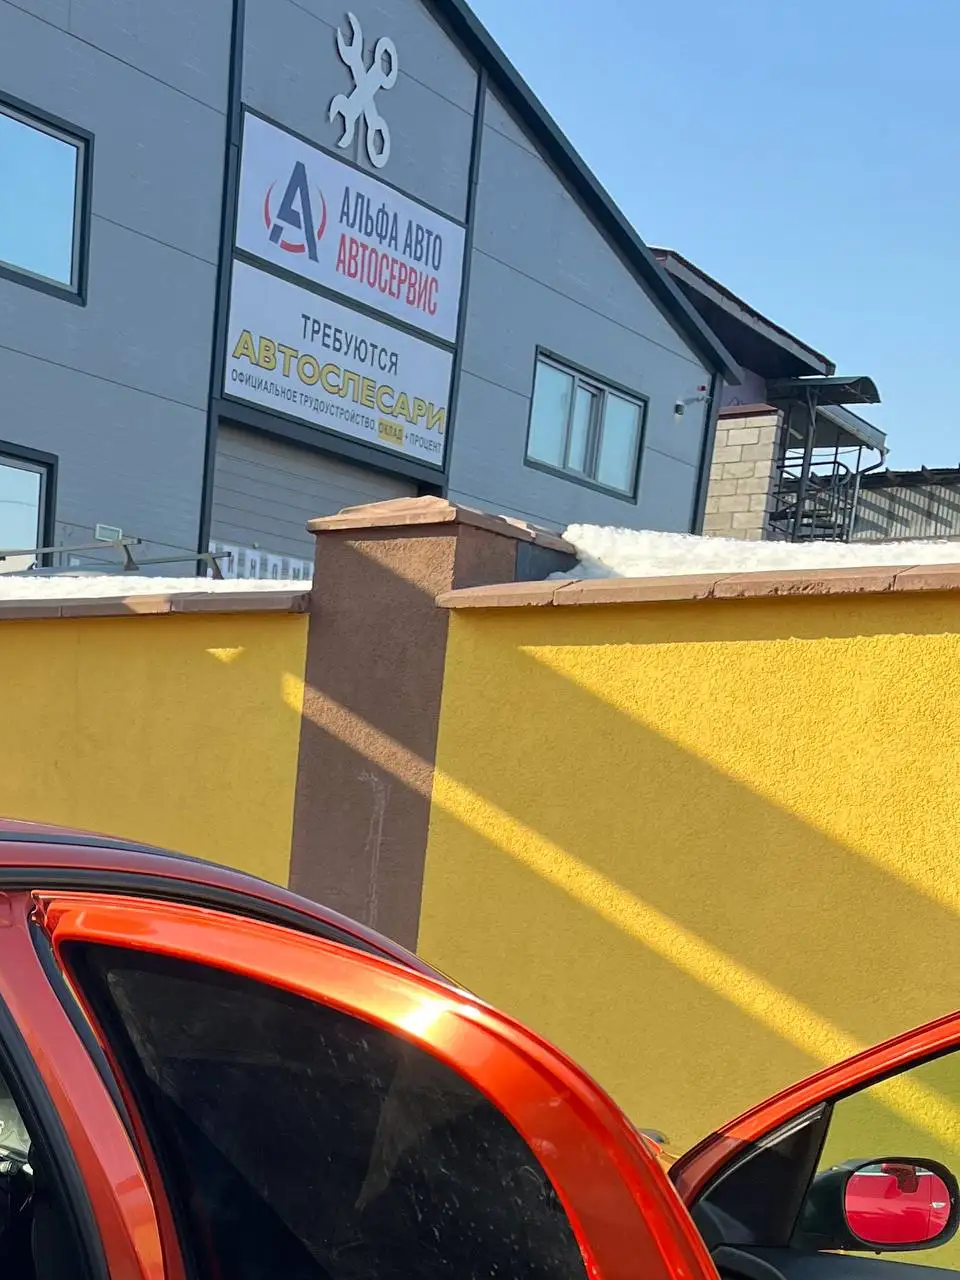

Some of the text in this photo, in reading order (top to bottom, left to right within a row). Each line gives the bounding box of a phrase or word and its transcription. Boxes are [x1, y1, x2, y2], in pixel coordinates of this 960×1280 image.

[339, 186, 443, 271] АЛЬФА АВТО
[336, 233, 440, 316] АВТОСЕРВИС
[232, 329, 445, 435] АВТОСЛЕСАРИ
[301, 313, 399, 376] ТРЕБУЮТСЯ
[231, 369, 297, 402] ОФИЦИАЛЬНОЕ
[409, 432, 442, 453] ПРОЦЕНТ
